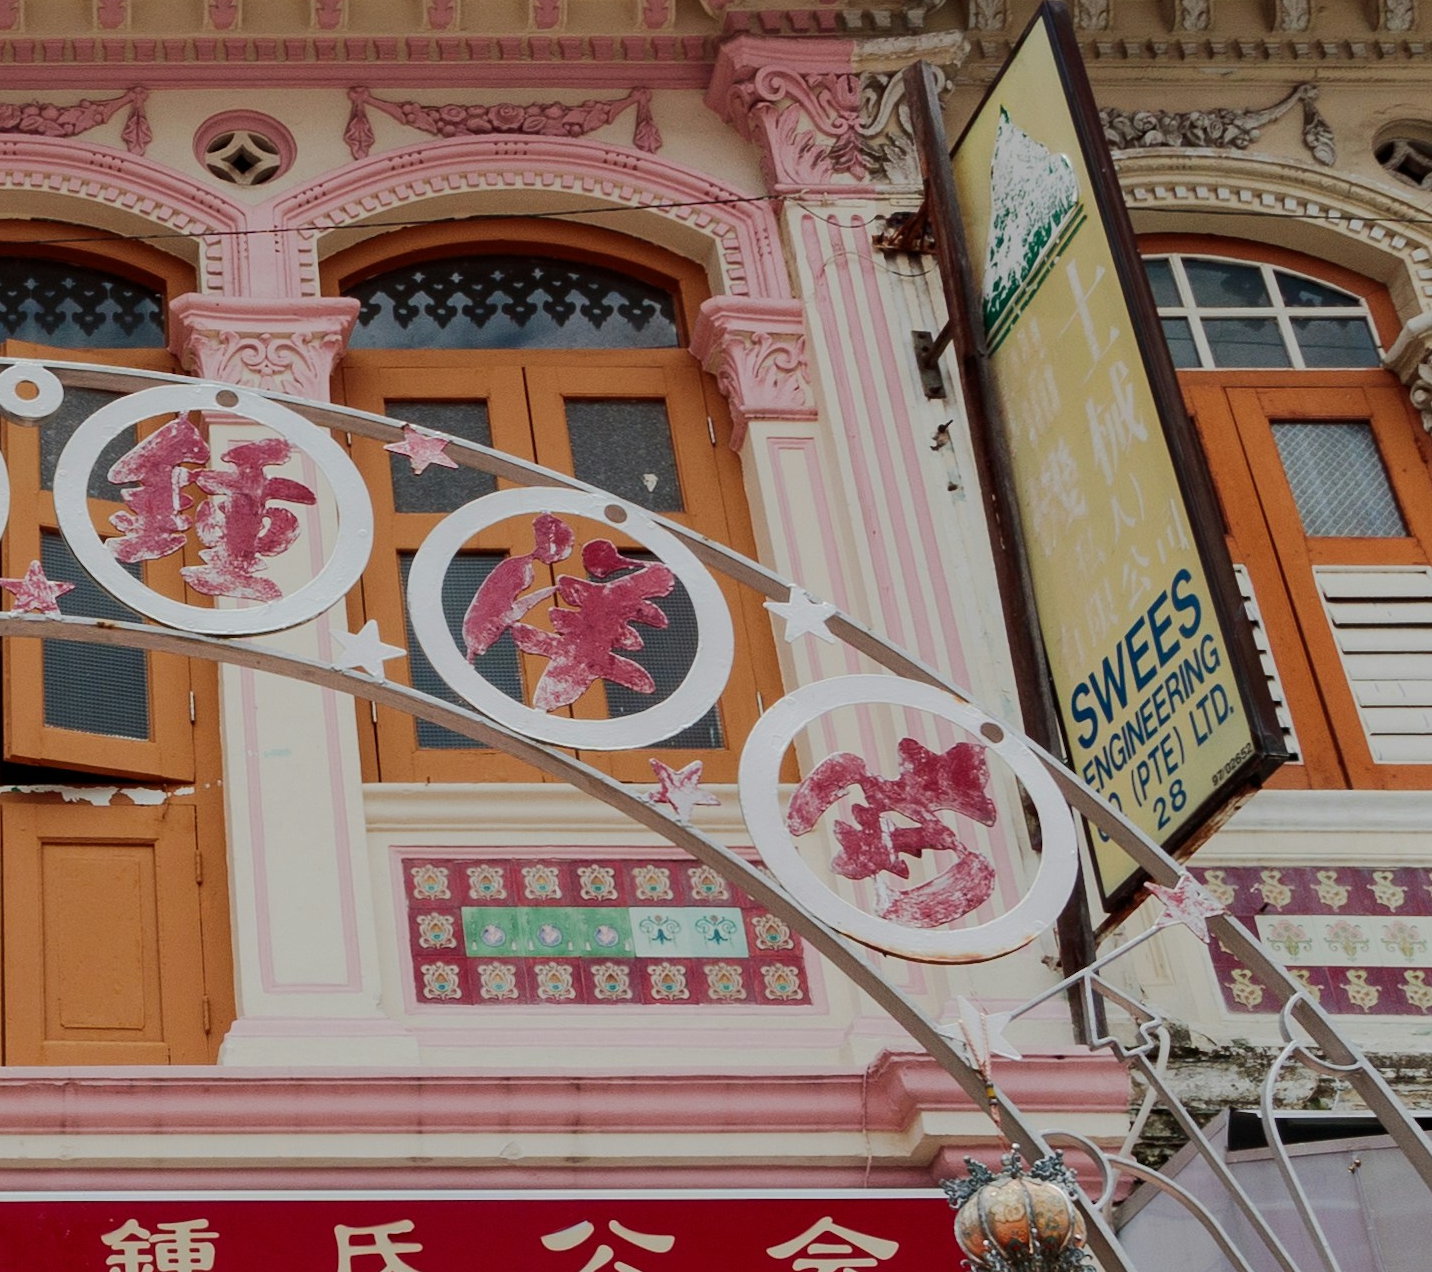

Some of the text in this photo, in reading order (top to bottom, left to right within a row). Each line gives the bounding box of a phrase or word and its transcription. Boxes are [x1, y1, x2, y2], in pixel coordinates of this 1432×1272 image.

[1071, 569, 1202, 749] SWEES
[1083, 634, 1221, 792] ENGINEERING
[1131, 683, 1234, 807] (PTE) LTD.
[1153, 778, 1187, 832] 28
